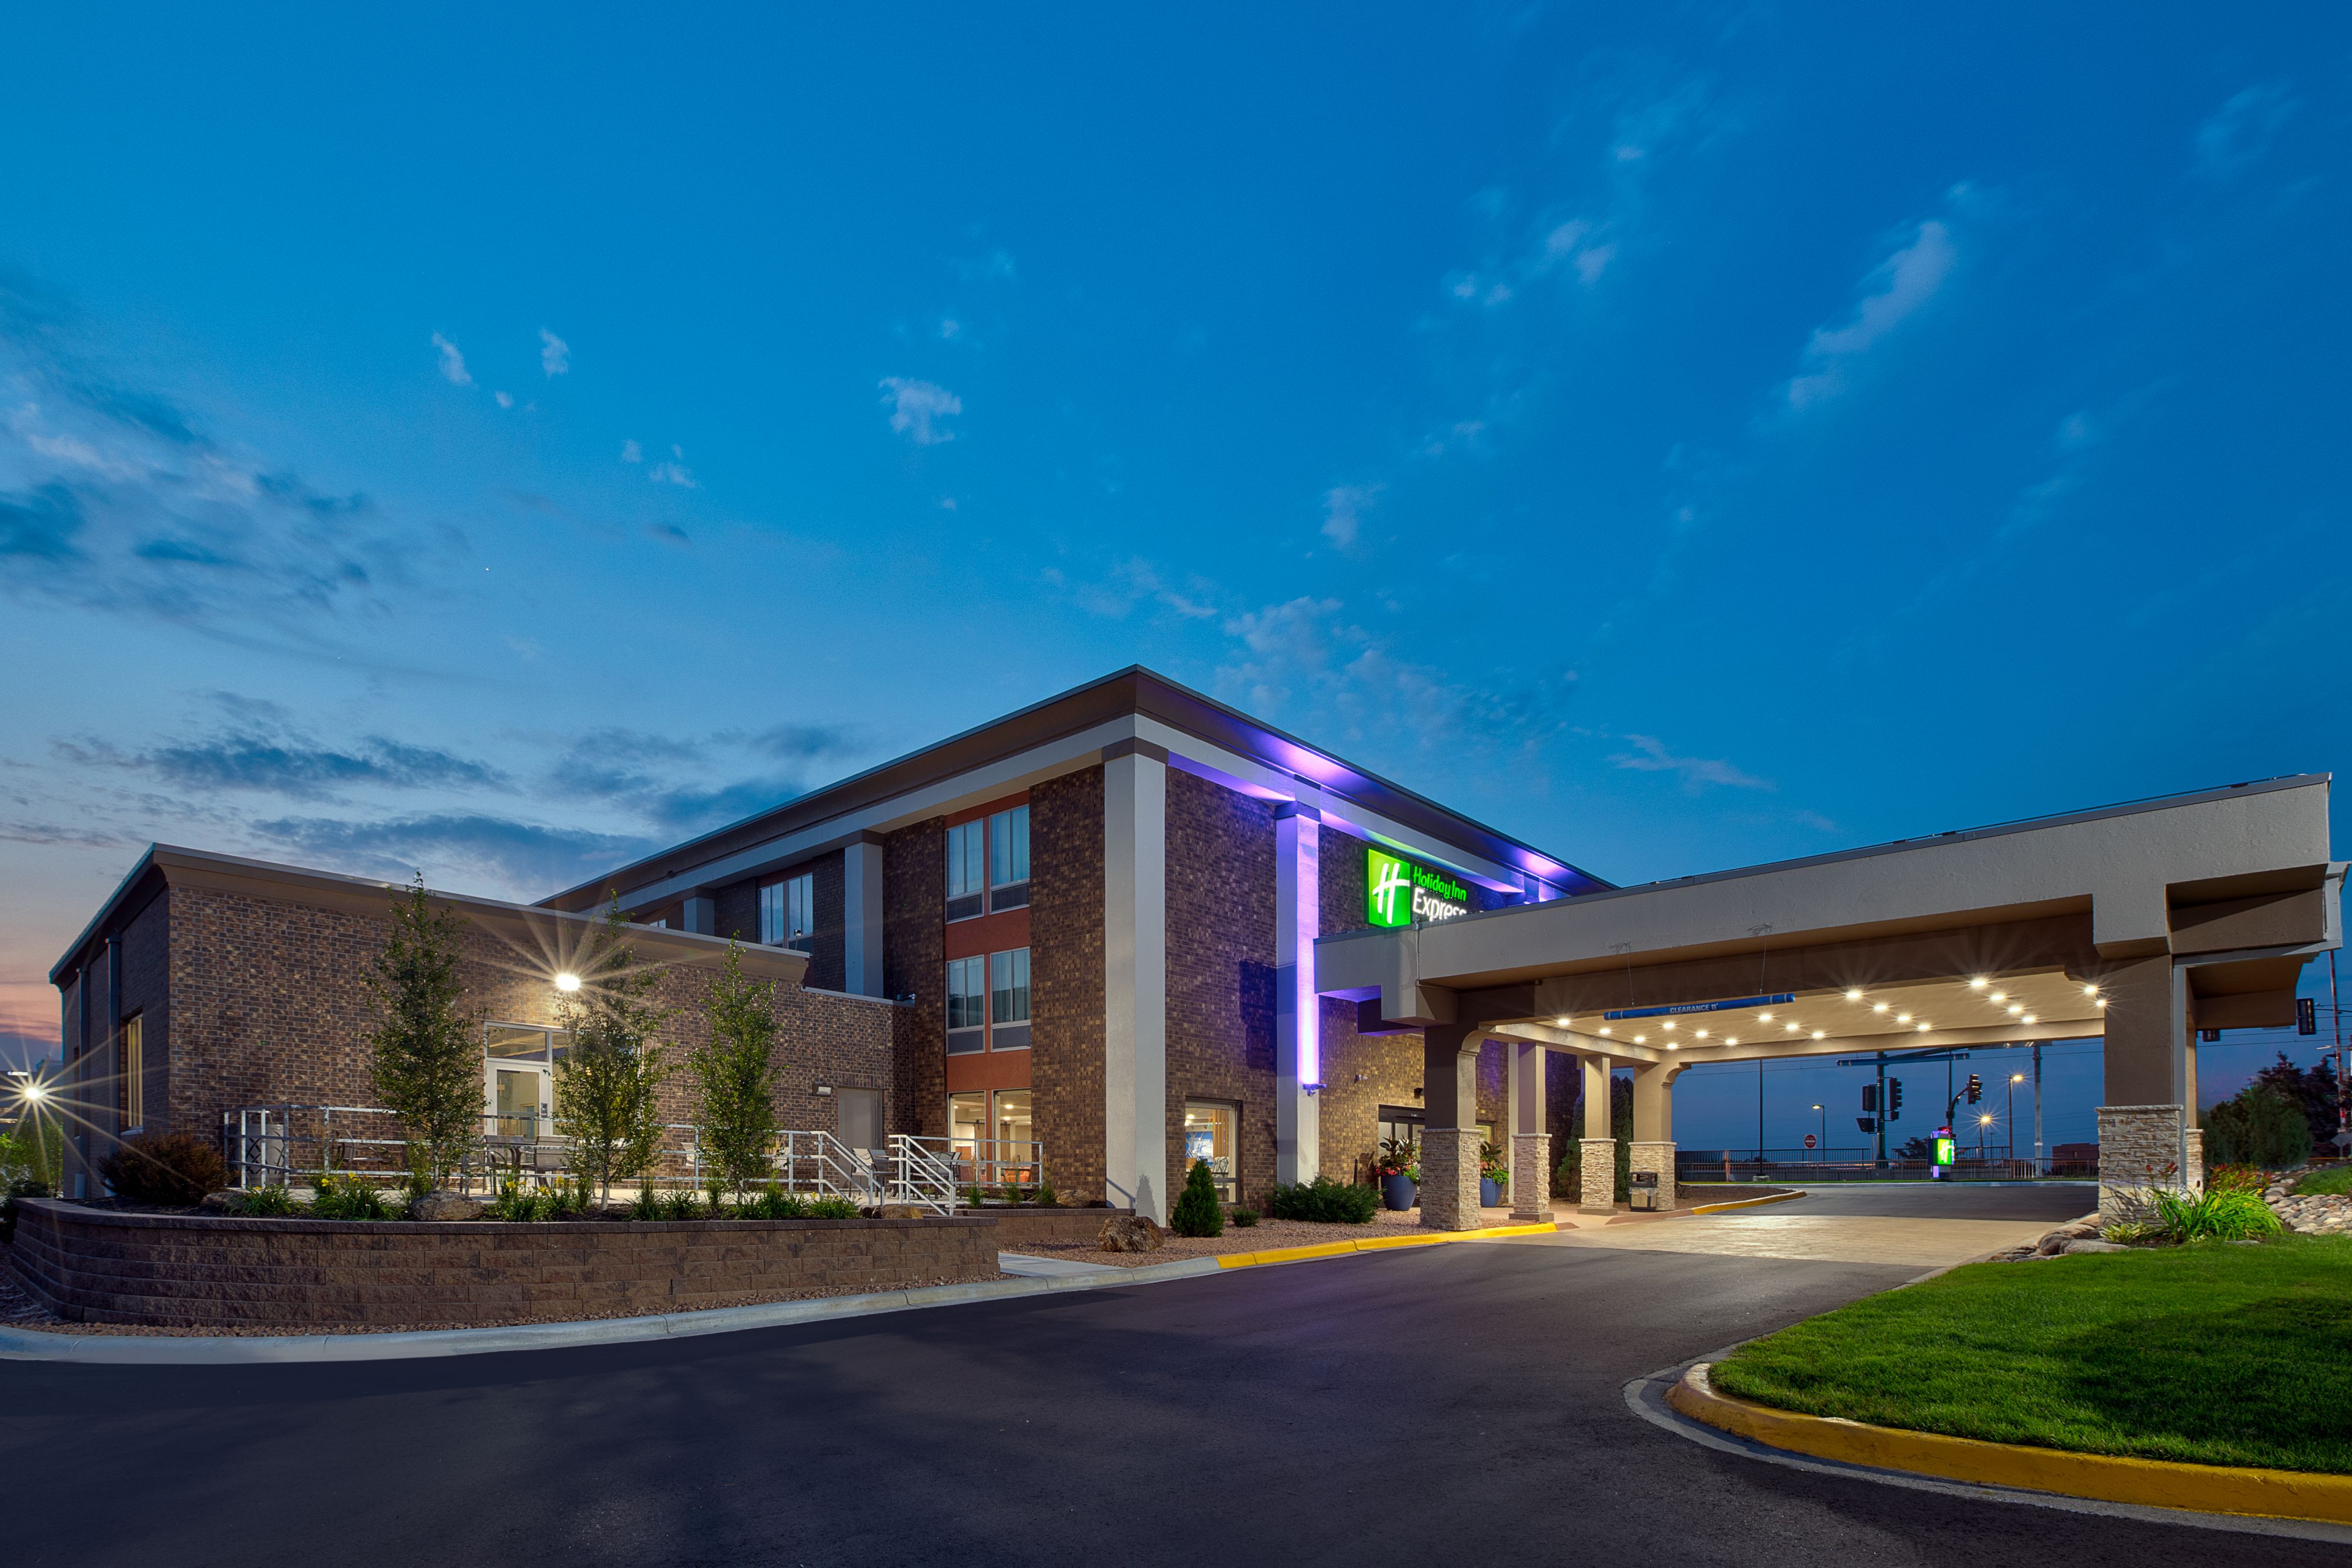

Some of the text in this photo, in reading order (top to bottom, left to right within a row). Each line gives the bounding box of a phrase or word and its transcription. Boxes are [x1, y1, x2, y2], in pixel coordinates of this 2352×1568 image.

[1413, 866, 1467, 901] Holiday Inn
[1670, 1004, 1709, 1014] CLEARANCE
